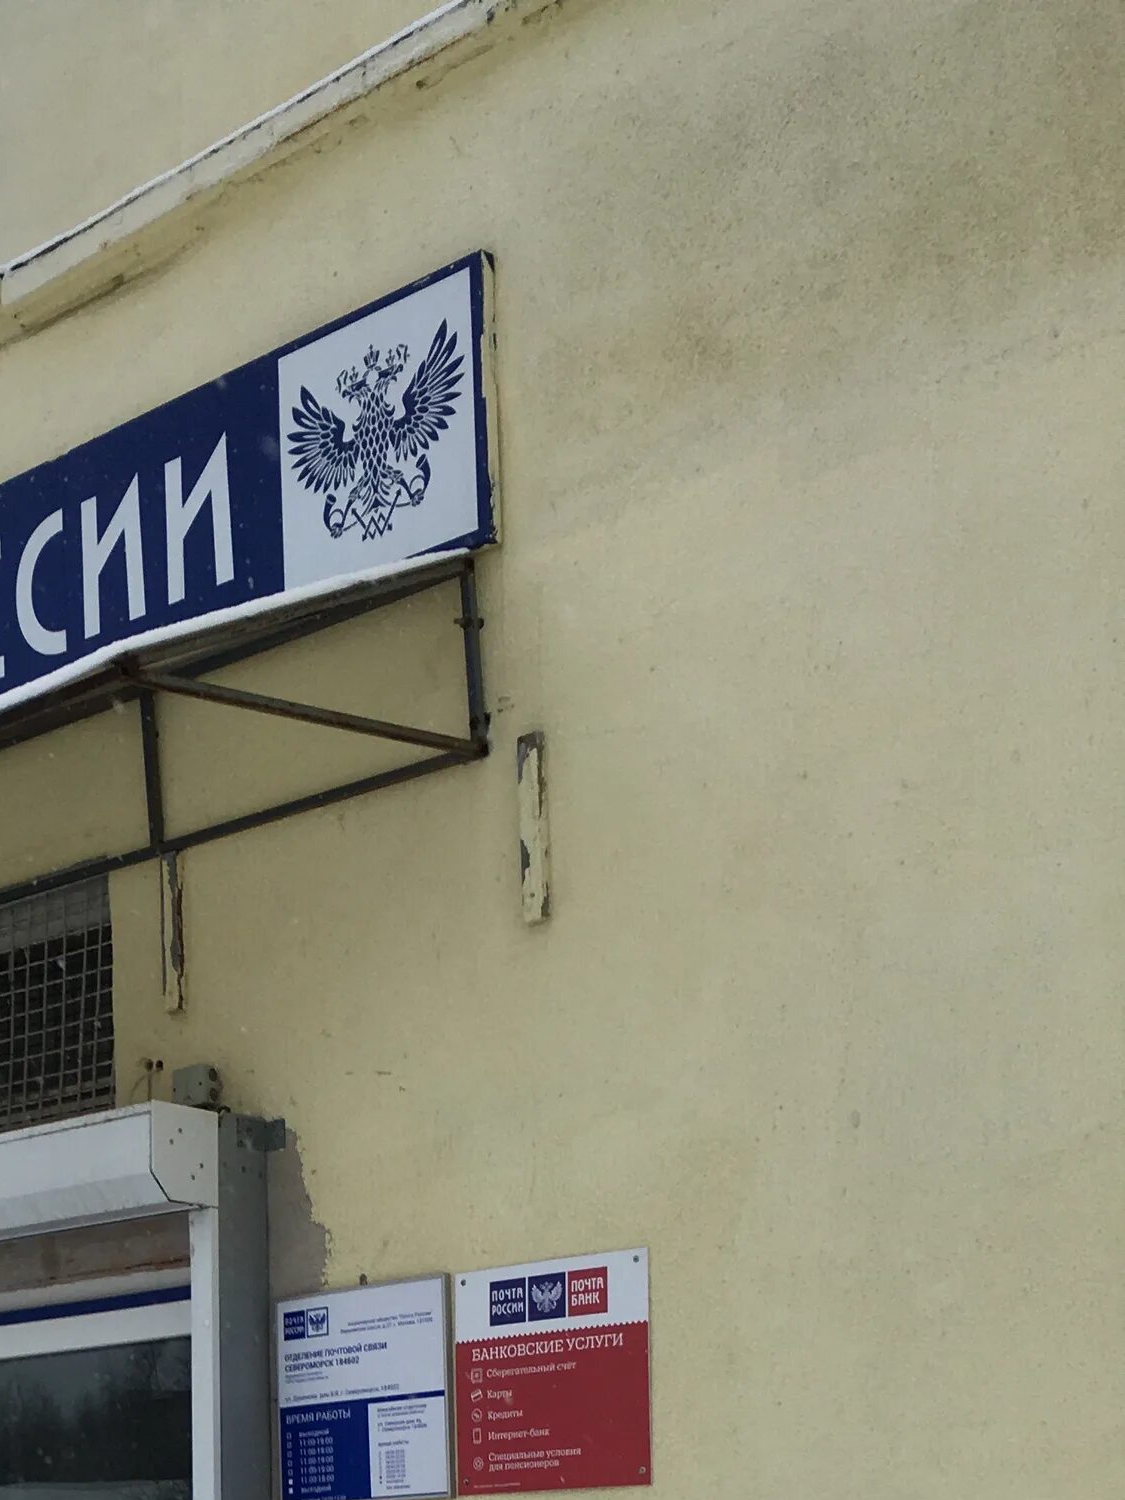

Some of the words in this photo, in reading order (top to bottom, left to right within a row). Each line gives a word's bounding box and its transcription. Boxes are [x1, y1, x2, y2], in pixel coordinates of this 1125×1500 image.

[572, 1277, 603, 1292] ПОЧТА
[492, 1287, 524, 1301] ПОЧТА
[572, 1292, 600, 1306] БАНК
[492, 1301, 524, 1316] РОССИИ
[284, 1350, 323, 1363] ОТДЕЛЕНИЕ
[324, 1342, 363, 1357] ПОЧТОВОЙ
[364, 1341, 388, 1352] СВЯЗИ
[472, 1339, 564, 1362] БАНКОВСКИЕ
[567, 1333, 624, 1351] УСЛУГИ
[284, 1360, 334, 1373] СЕВЕРОМОРСК
[486, 1363, 556, 1379] Сберегательный
[487, 1389, 512, 1401] Карты
[286, 1411, 315, 1425] ВРЕМЯ
[316, 1407, 351, 1421] РАБОТЫ
[487, 1408, 523, 1421] Кредиты
[488, 1428, 550, 1441] Интернет-банк
[488, 1450, 545, 1462] Специальные
[546, 1447, 582, 1459] условия
[488, 1463, 503, 1473] для
[504, 1459, 560, 1471] пенсионеров
